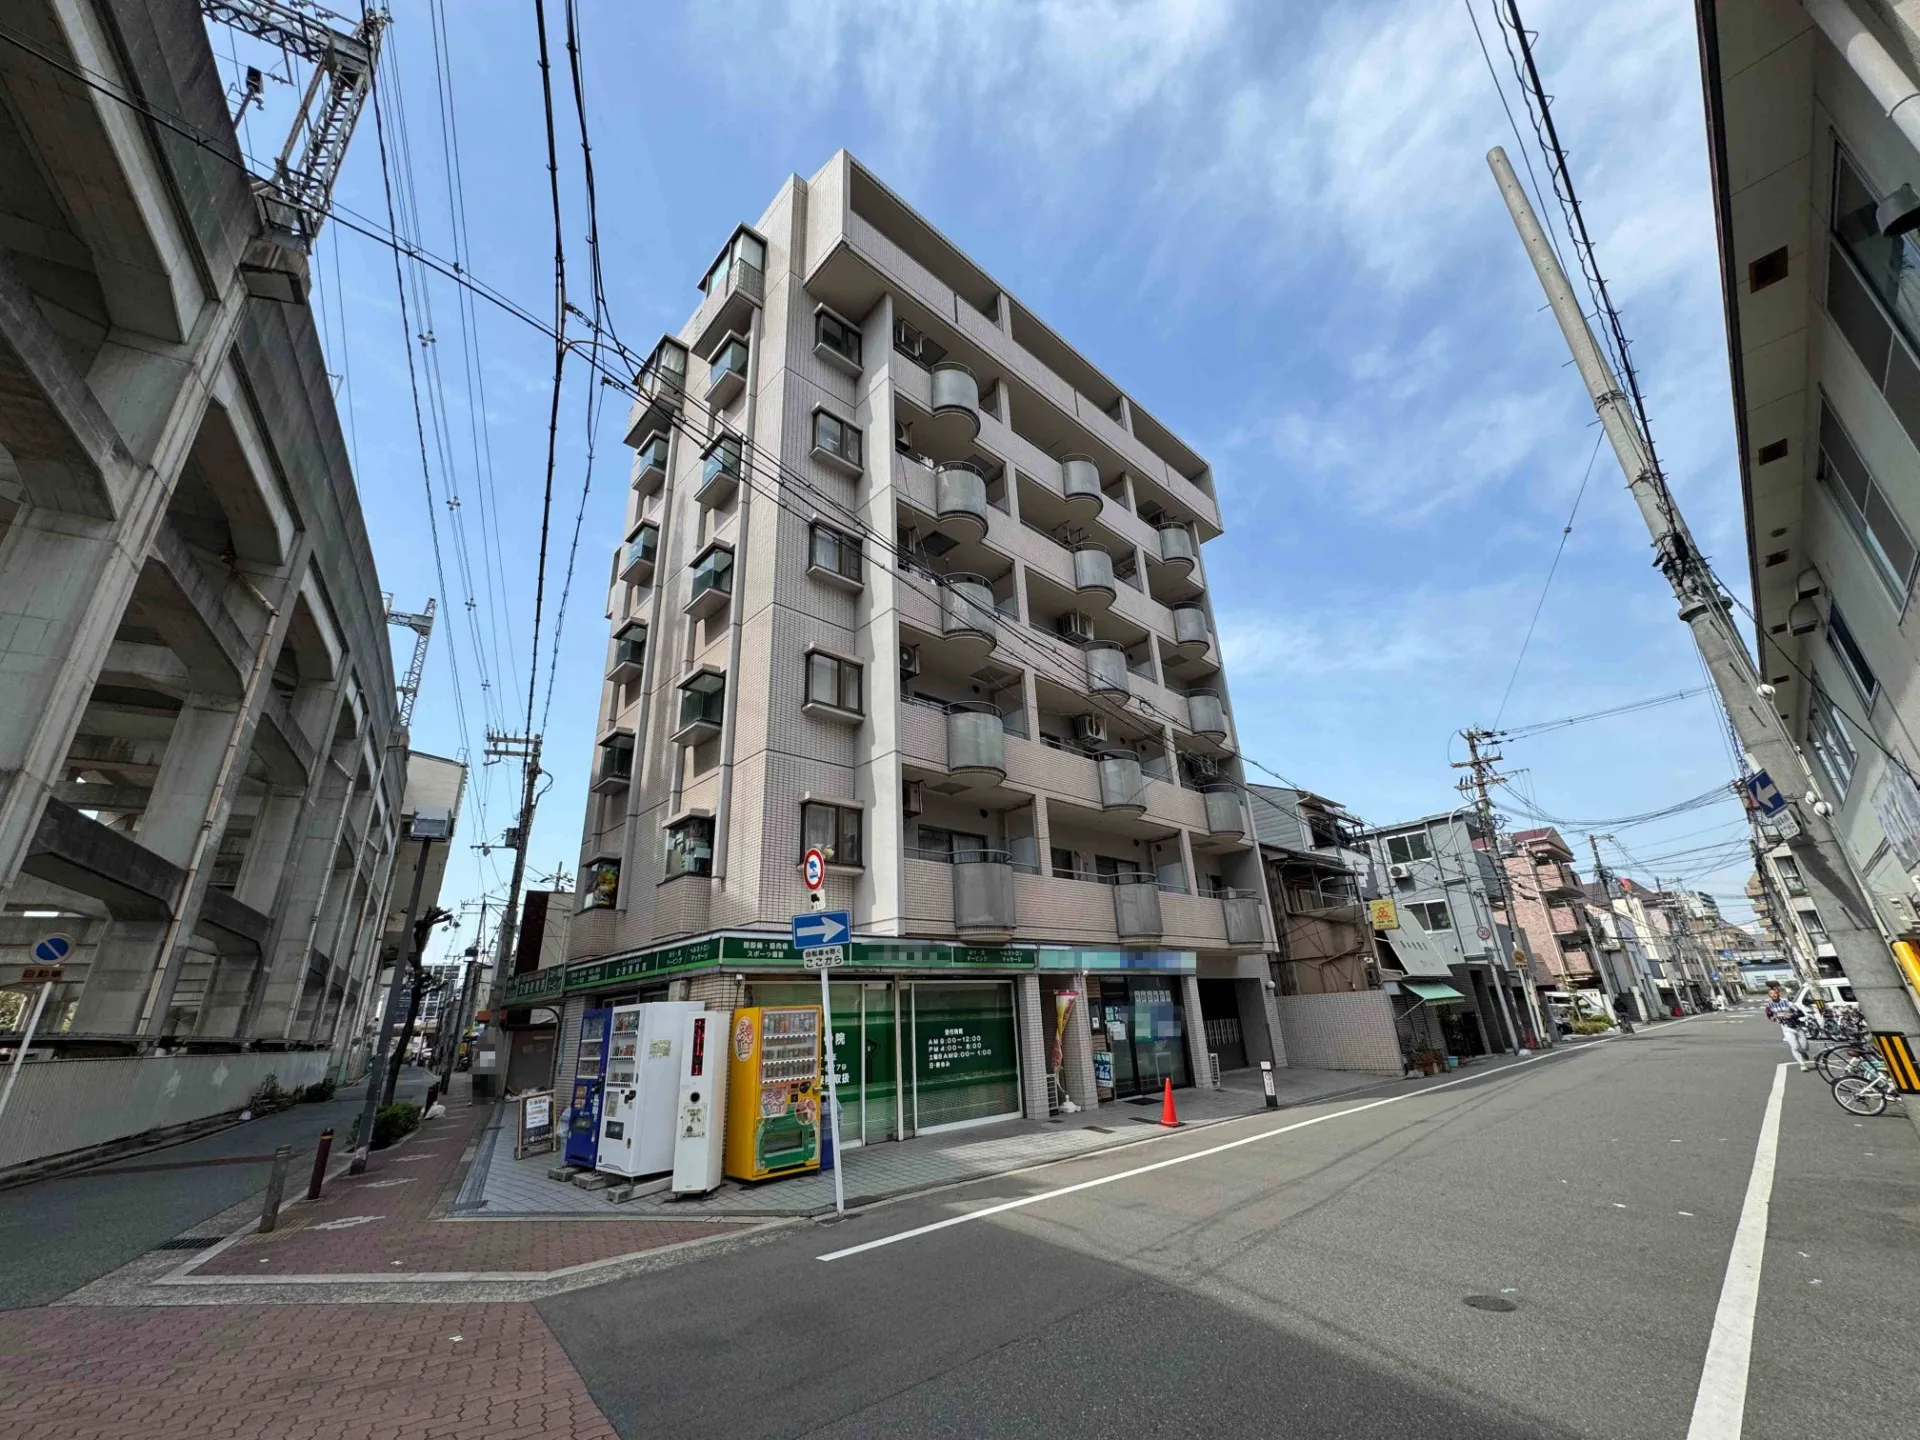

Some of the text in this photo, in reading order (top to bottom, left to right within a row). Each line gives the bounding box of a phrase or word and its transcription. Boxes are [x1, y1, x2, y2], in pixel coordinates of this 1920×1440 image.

[805, 948, 841, 958] 自転車を除く
[805, 955, 842, 968] ここから
[23, 969, 62, 978] 自動車
